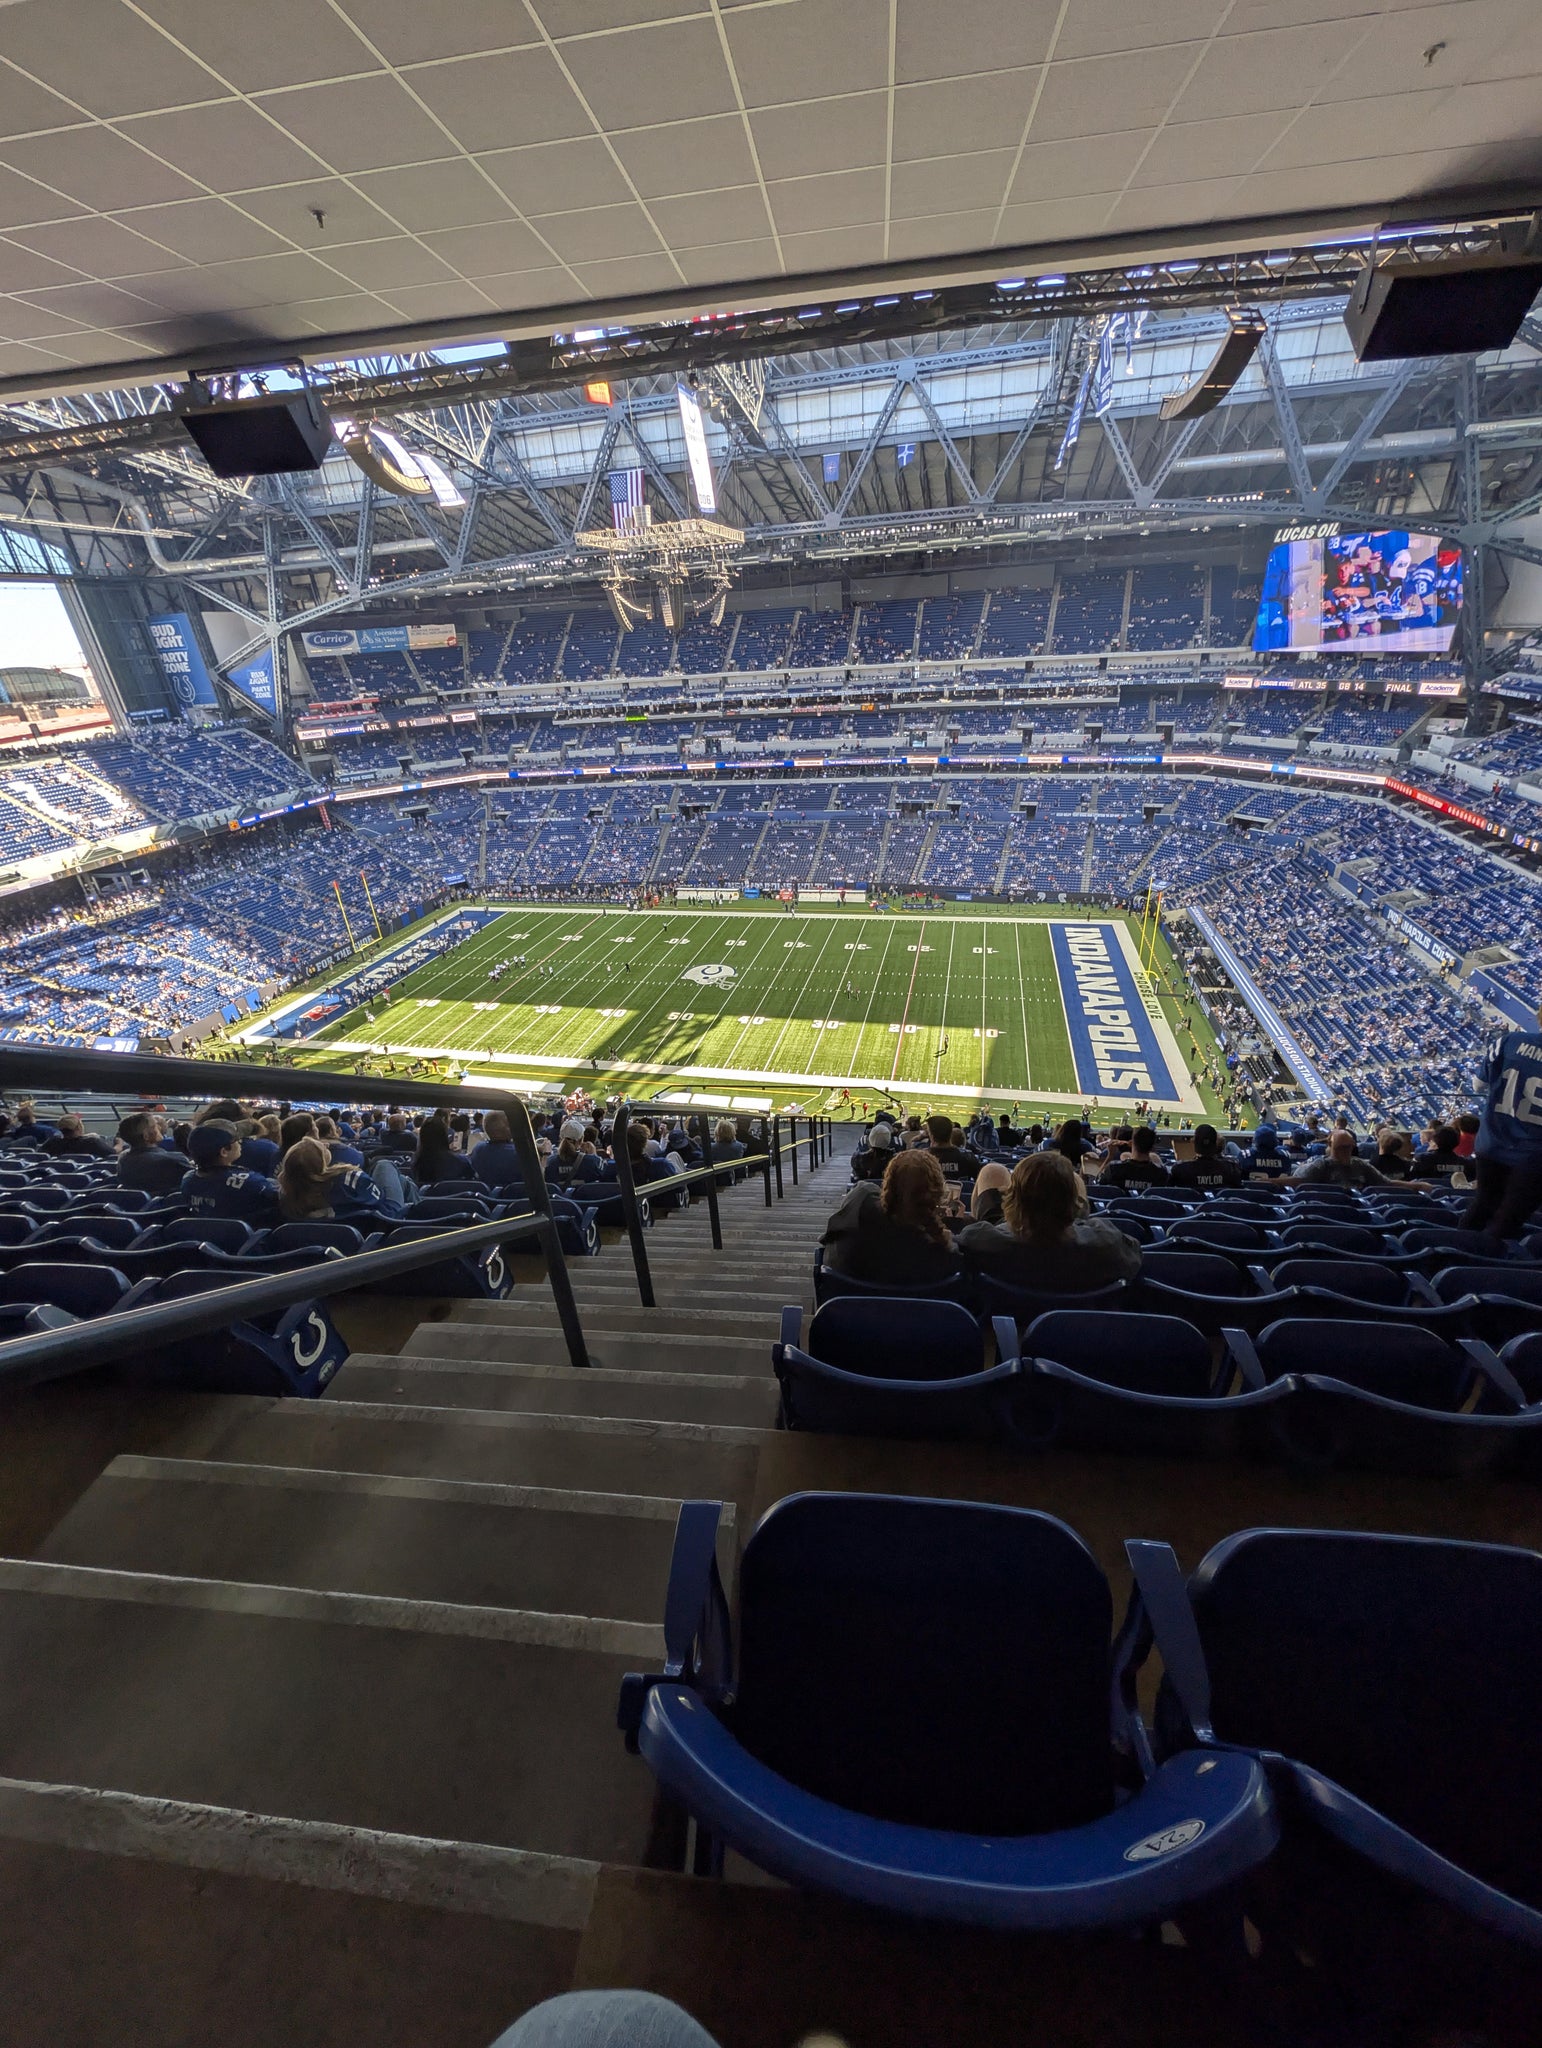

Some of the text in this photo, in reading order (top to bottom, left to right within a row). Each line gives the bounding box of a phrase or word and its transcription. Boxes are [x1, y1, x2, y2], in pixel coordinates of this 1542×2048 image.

[1274, 522, 1341, 543] LUCAS OIL
[150, 624, 175, 637] BUD
[374, 629, 404, 637] Ascension
[155, 635, 185, 649] IGHT
[313, 633, 349, 645] Carrier
[384, 634, 407, 643] Vincent
[164, 662, 191, 673] ZONE
[1298, 681, 1313, 689] ATL
[1315, 681, 1327, 690] 35
[1338, 682, 1351, 691] GB
[1354, 682, 1365, 691] 14
[1385, 683, 1413, 693] FINAL
[1424, 684, 1456, 693] Academy
[366, 724, 379, 732] ATL
[430, 716, 449, 724] FINAL
[316, 956, 332, 971] FOR
[333, 946, 352, 960] THE
[1133, 971, 1163, 1019] CHOOSE LOVE
[420, 999, 441, 1008] 10
[477, 1002, 500, 1011] 20
[538, 1005, 563, 1014] 30
[600, 1008, 627, 1018] 40
[1064, 927, 1155, 1092] INDIANAPOLIS
[667, 1011, 695, 1021] 50
[738, 1015, 766, 1025] 40
[811, 1019, 839, 1029] 30
[888, 1023, 917, 1034] 20
[973, 1028, 999, 1038] 10
[1277, 1036, 1297, 1055] LUCAS
[1297, 1064, 1324, 1095] STADIUM
[1494, 1067, 1542, 1126] 18
[1255, 1158, 1283, 1168] WARREN
[1124, 1179, 1152, 1189] WARREN
[1196, 1175, 1223, 1185] TAYLOR
